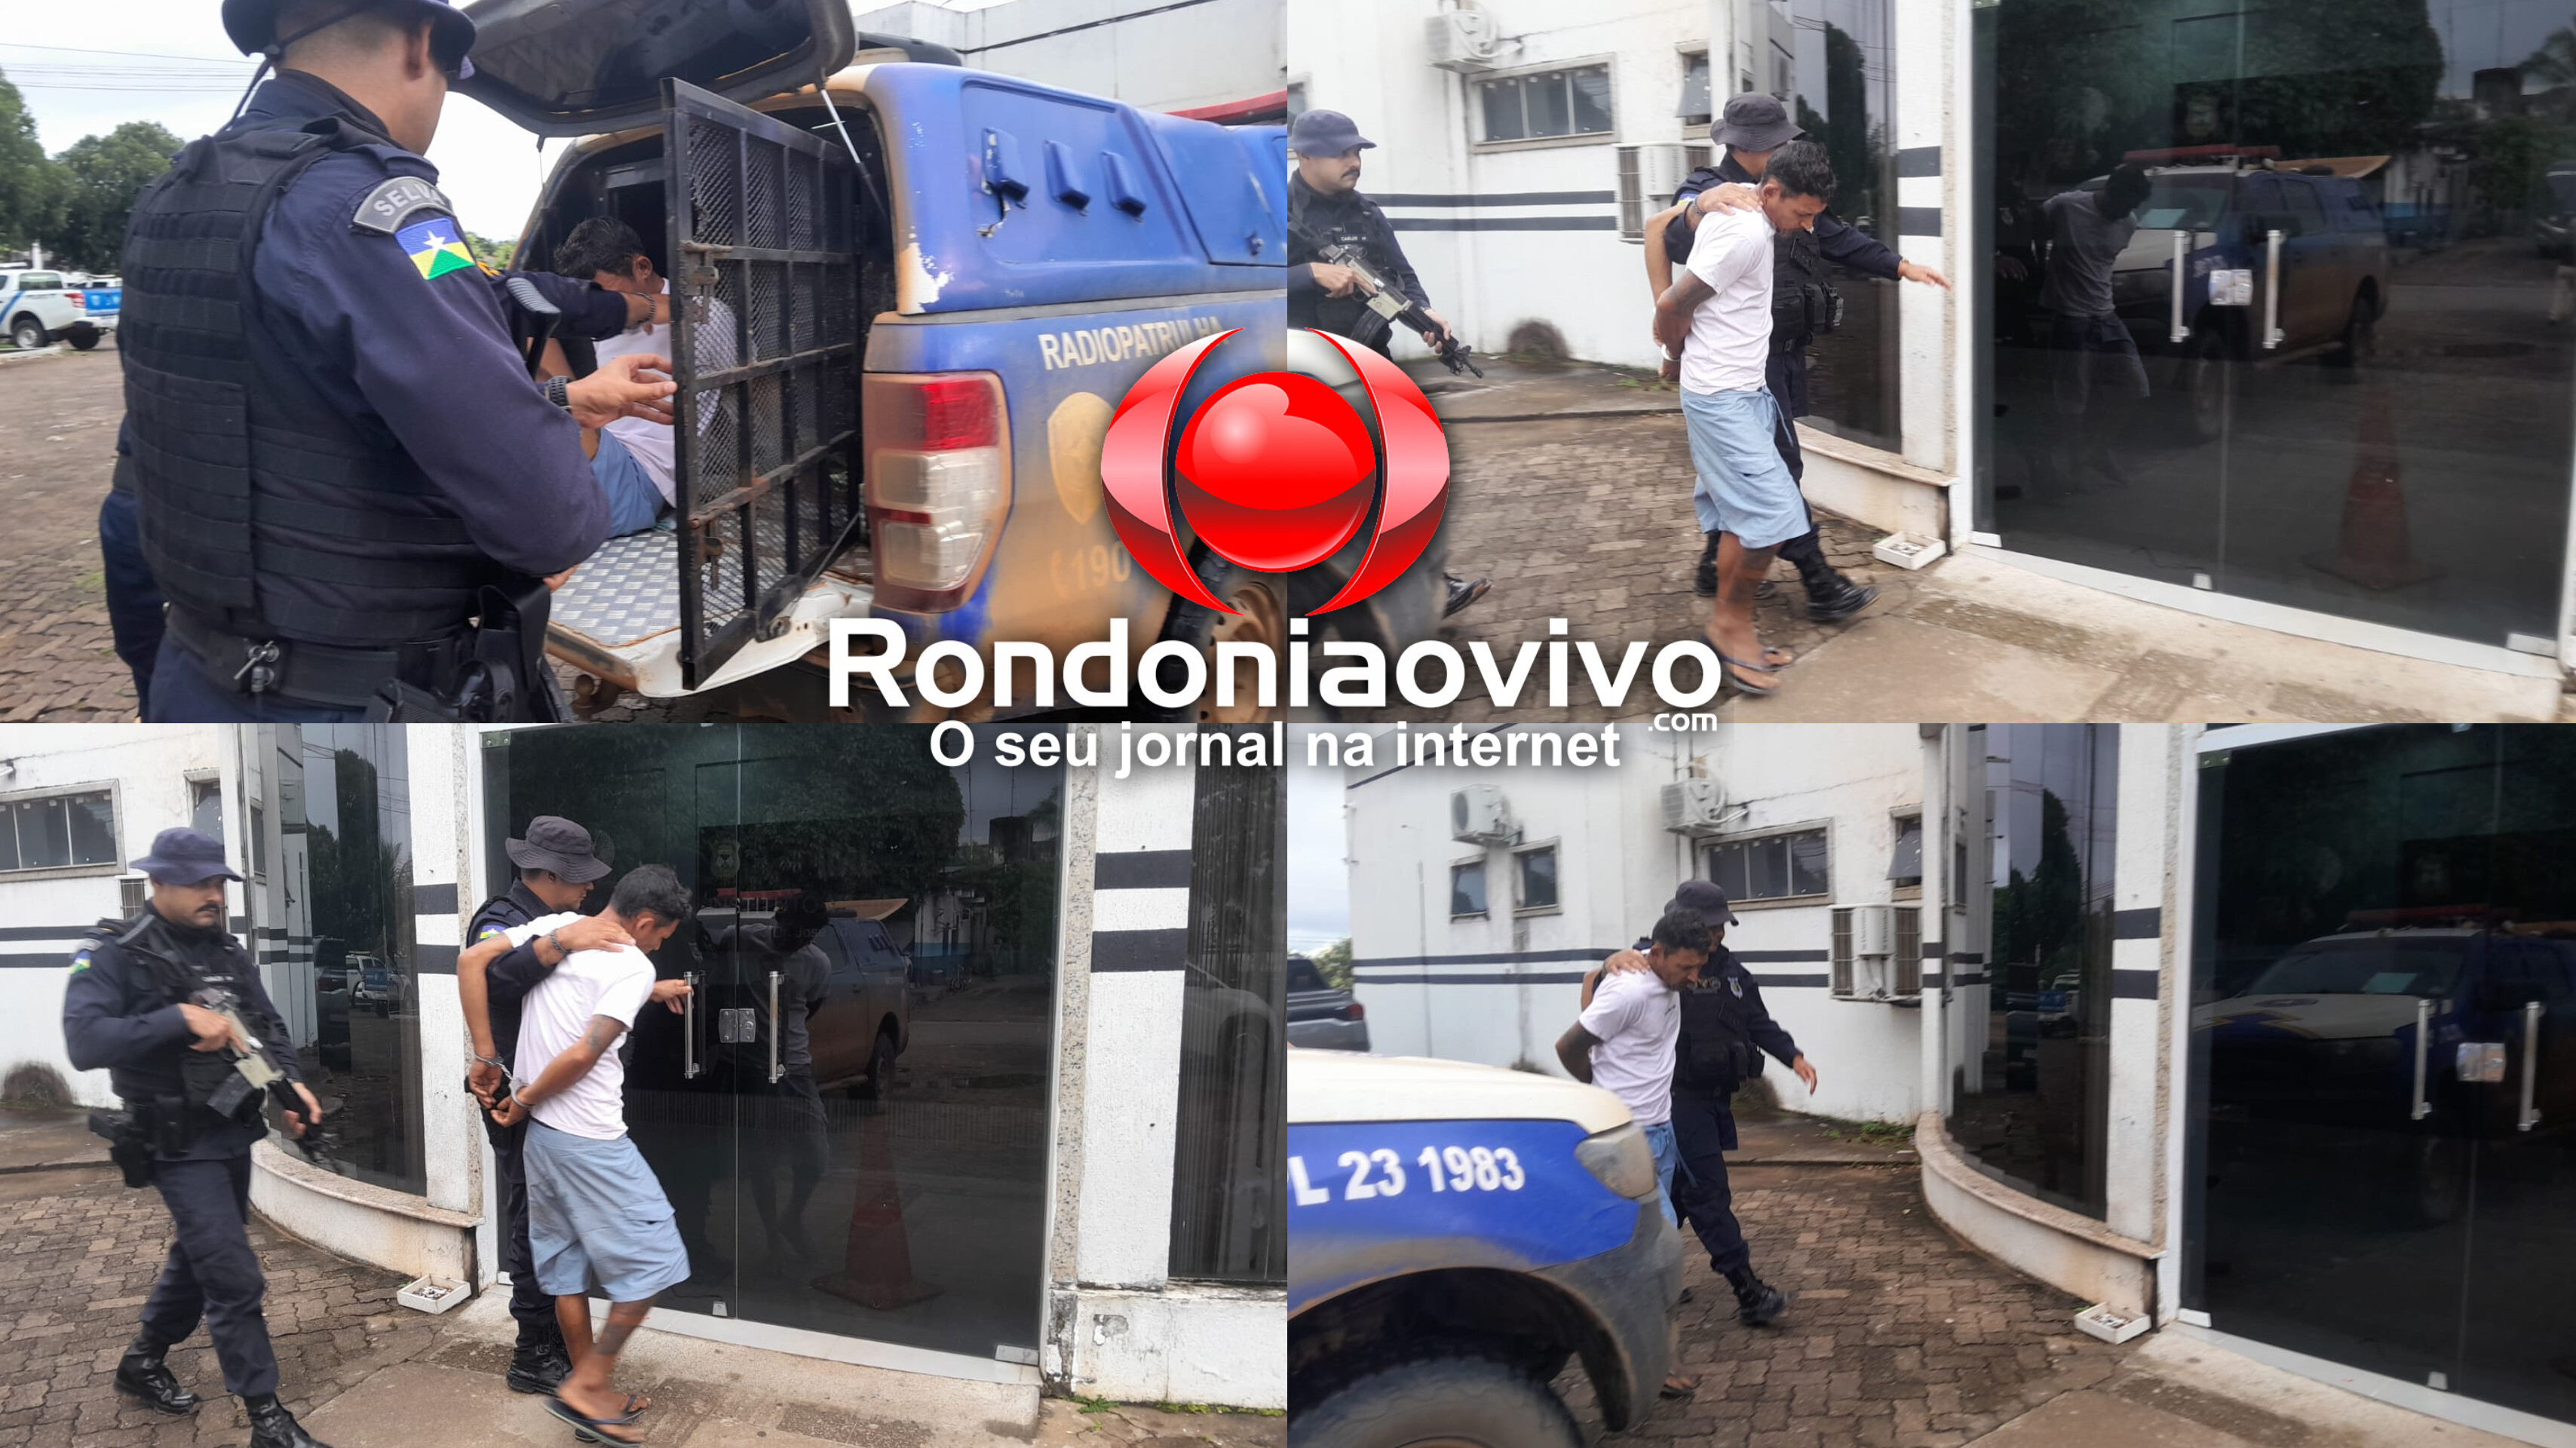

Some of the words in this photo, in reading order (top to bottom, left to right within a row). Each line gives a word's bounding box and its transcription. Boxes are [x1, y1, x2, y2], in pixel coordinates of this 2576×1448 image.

[374, 184, 445, 216] SELVA
[1286, 1156, 1329, 1206] L
[1337, 1148, 1406, 1201] 23
[1417, 1146, 1525, 1192] 1983
